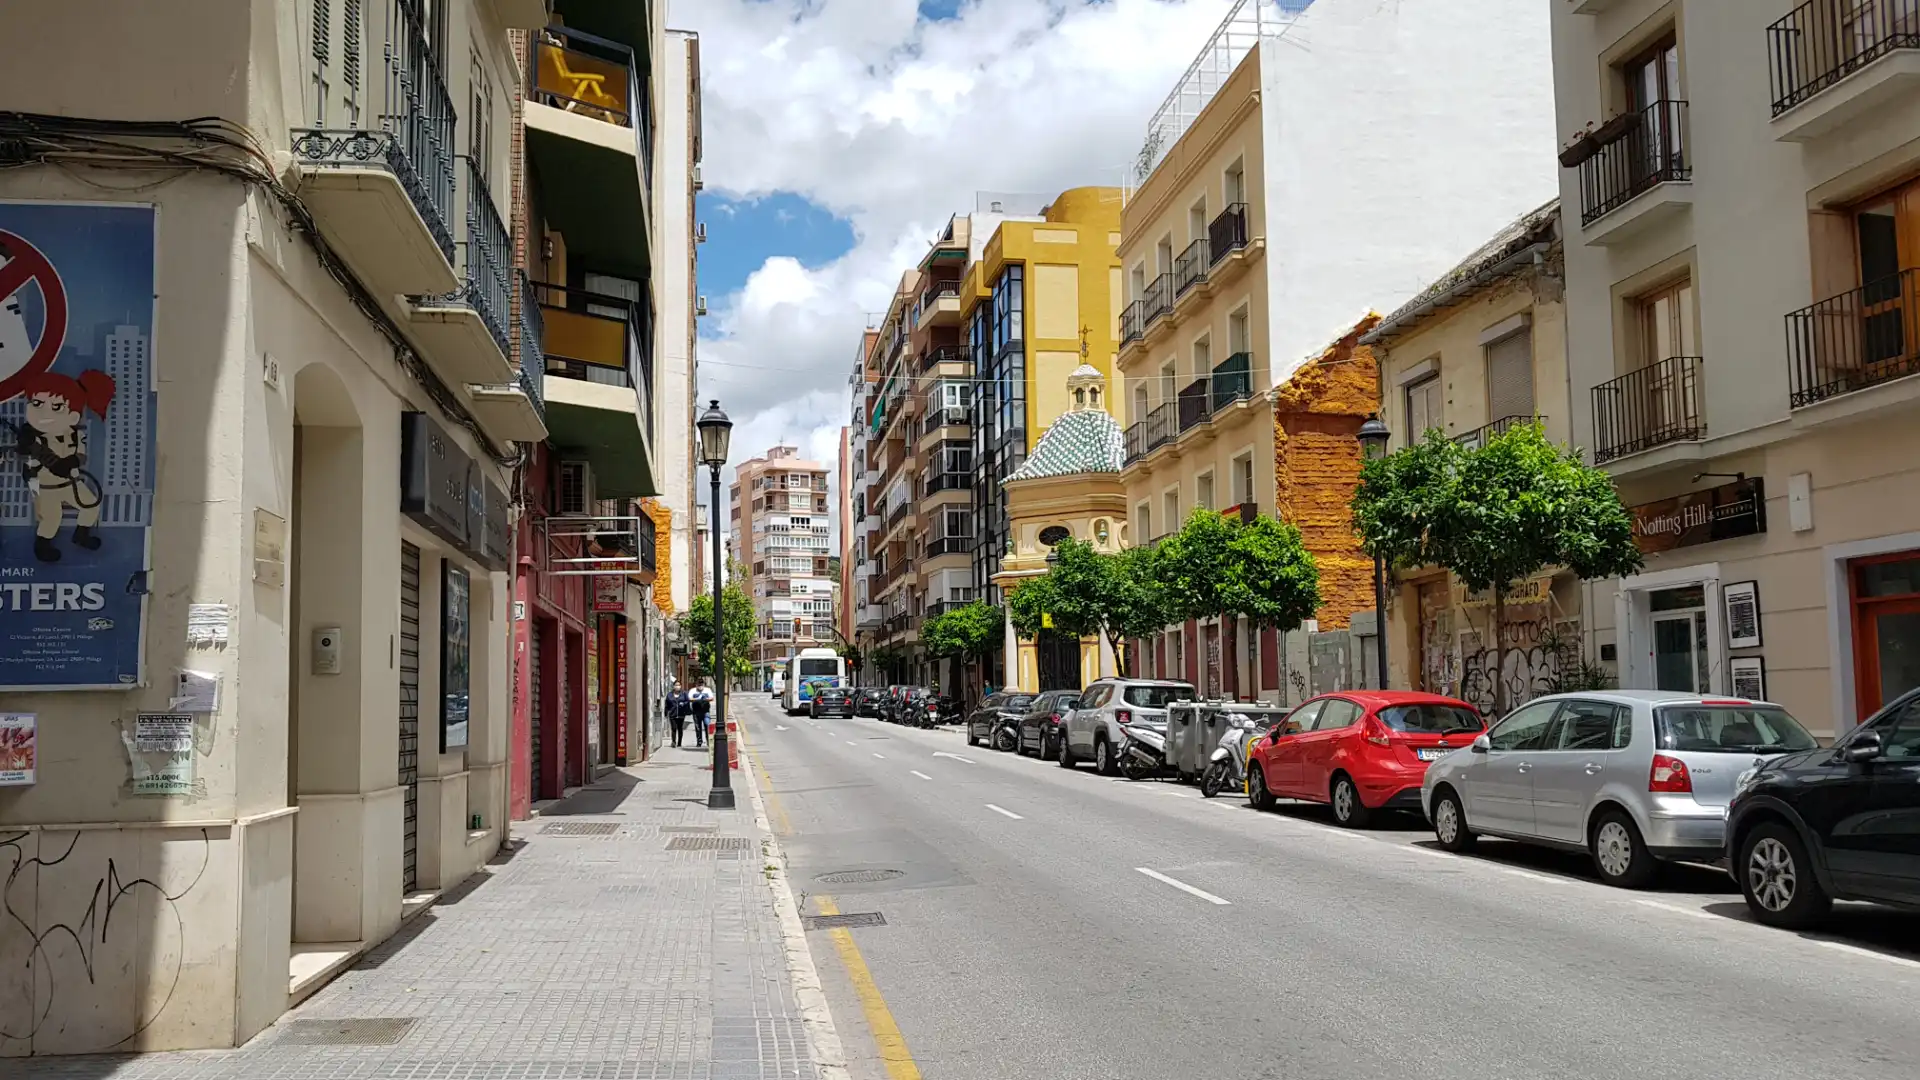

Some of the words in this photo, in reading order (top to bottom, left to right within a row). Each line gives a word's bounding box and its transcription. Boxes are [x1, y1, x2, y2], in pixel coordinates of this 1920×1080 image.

[1638, 513, 1682, 537] Notting
[1683, 503, 1707, 528] Hill
[0, 567, 35, 577] MAR?
[0, 582, 105, 611] TERS
